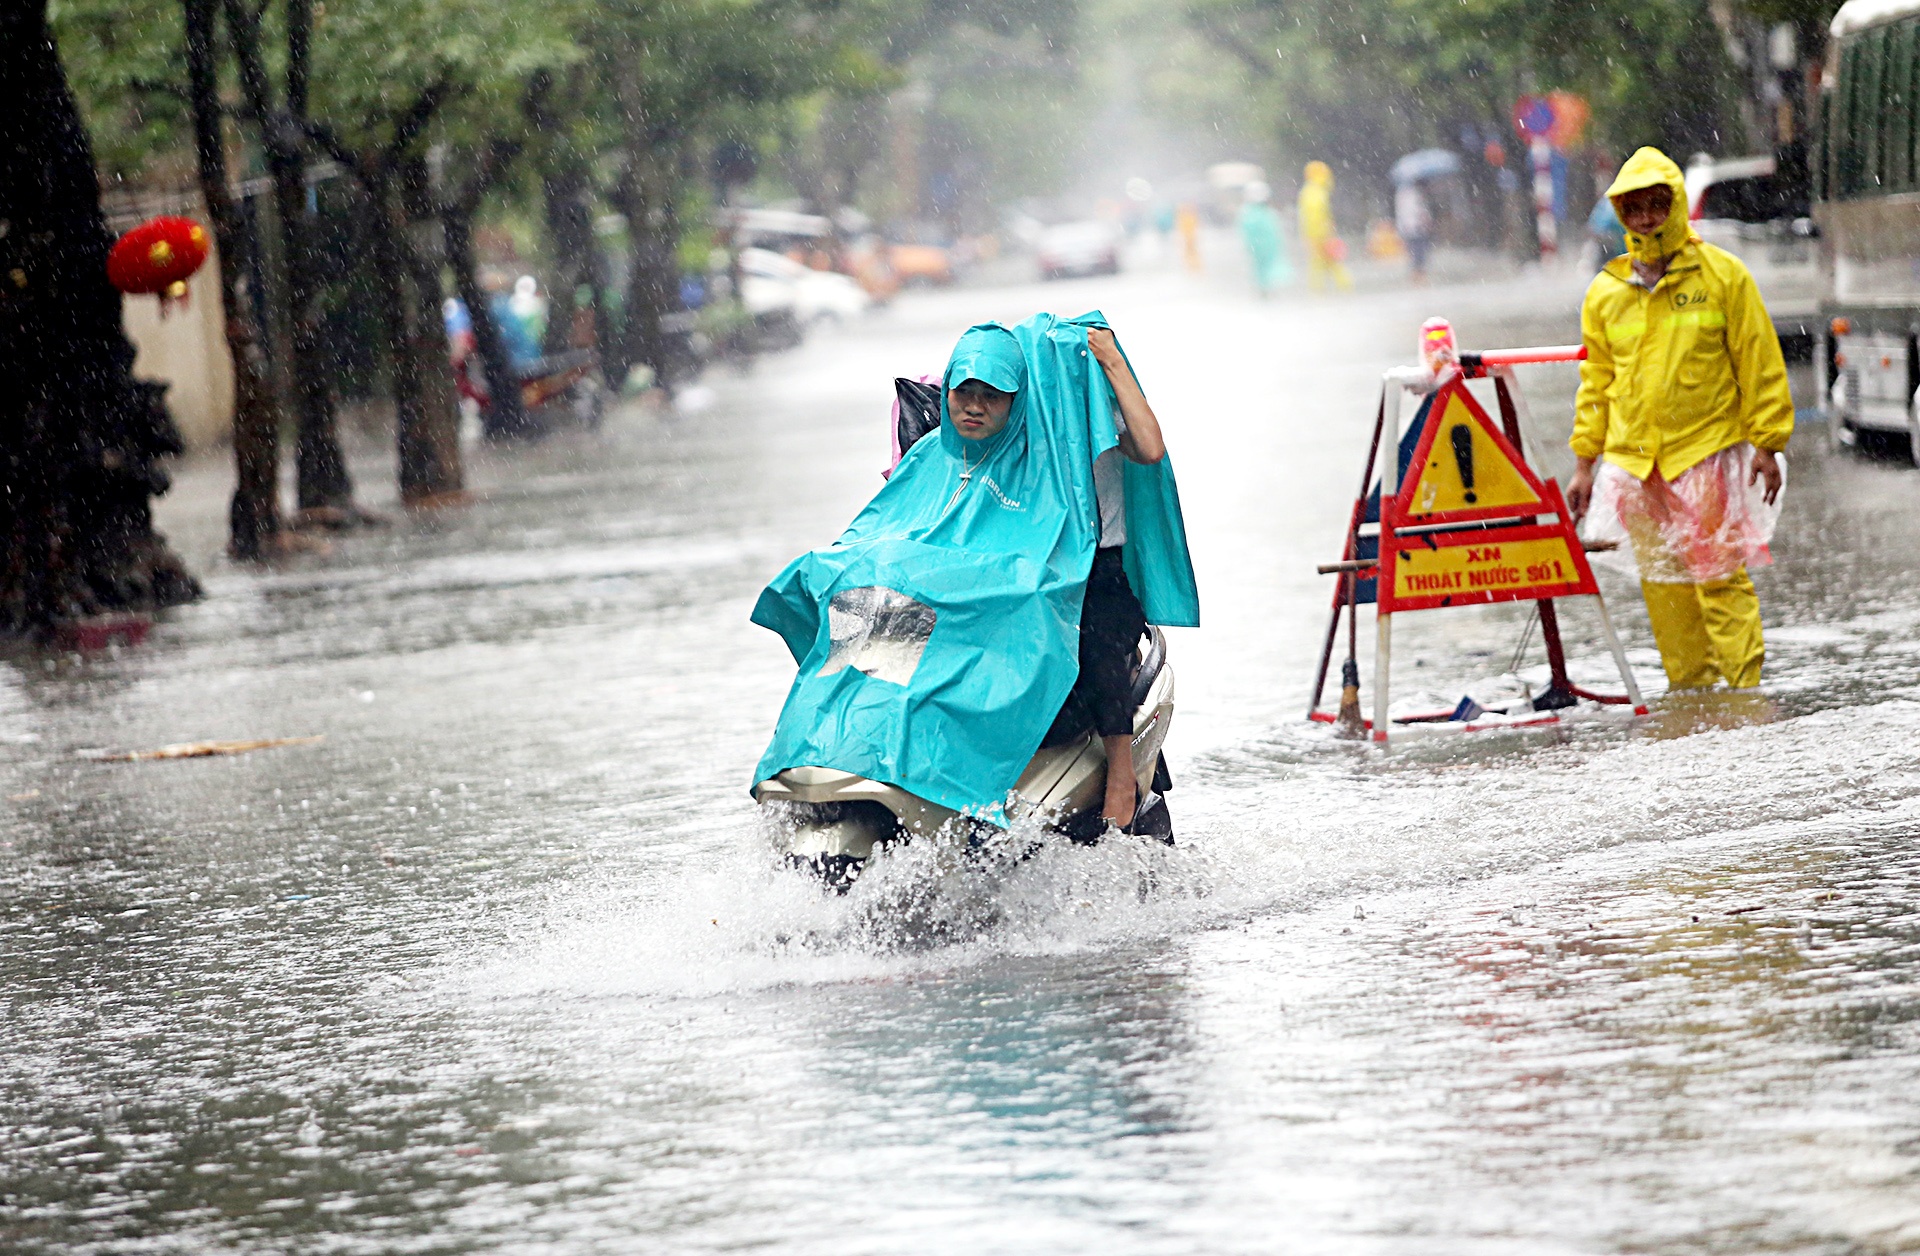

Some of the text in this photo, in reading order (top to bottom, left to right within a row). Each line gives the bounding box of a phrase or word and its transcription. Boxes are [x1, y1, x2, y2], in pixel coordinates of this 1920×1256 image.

[1466, 546, 1502, 563] XN
[1405, 568, 1462, 591] THOÁT
[1468, 563, 1520, 587] NƯỚC
